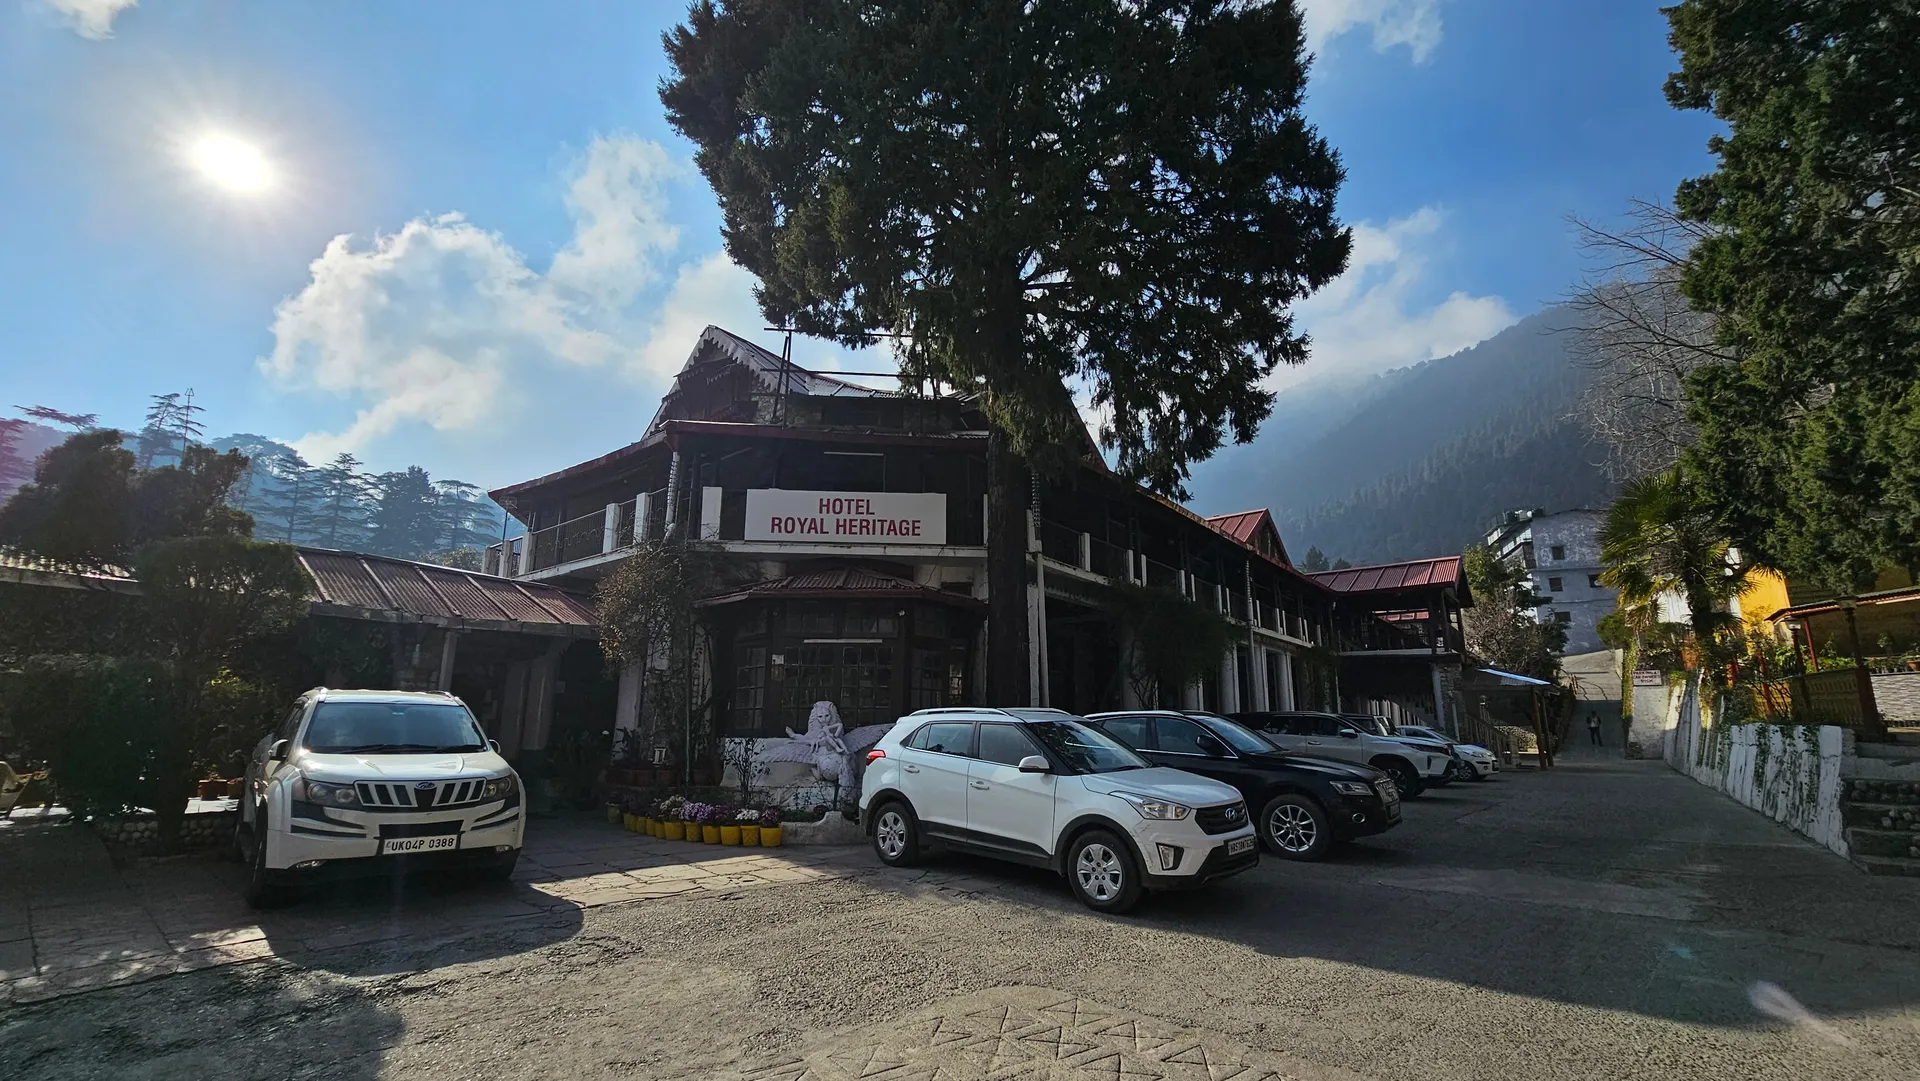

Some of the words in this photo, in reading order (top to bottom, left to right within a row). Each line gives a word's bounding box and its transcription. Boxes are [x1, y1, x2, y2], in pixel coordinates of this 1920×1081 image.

[819, 498, 875, 515] HOTEL
[770, 516, 829, 534] ROYAL
[835, 518, 921, 537] HERITAGE
[391, 840, 425, 851] UK04P
[428, 838, 455, 848] 0388
